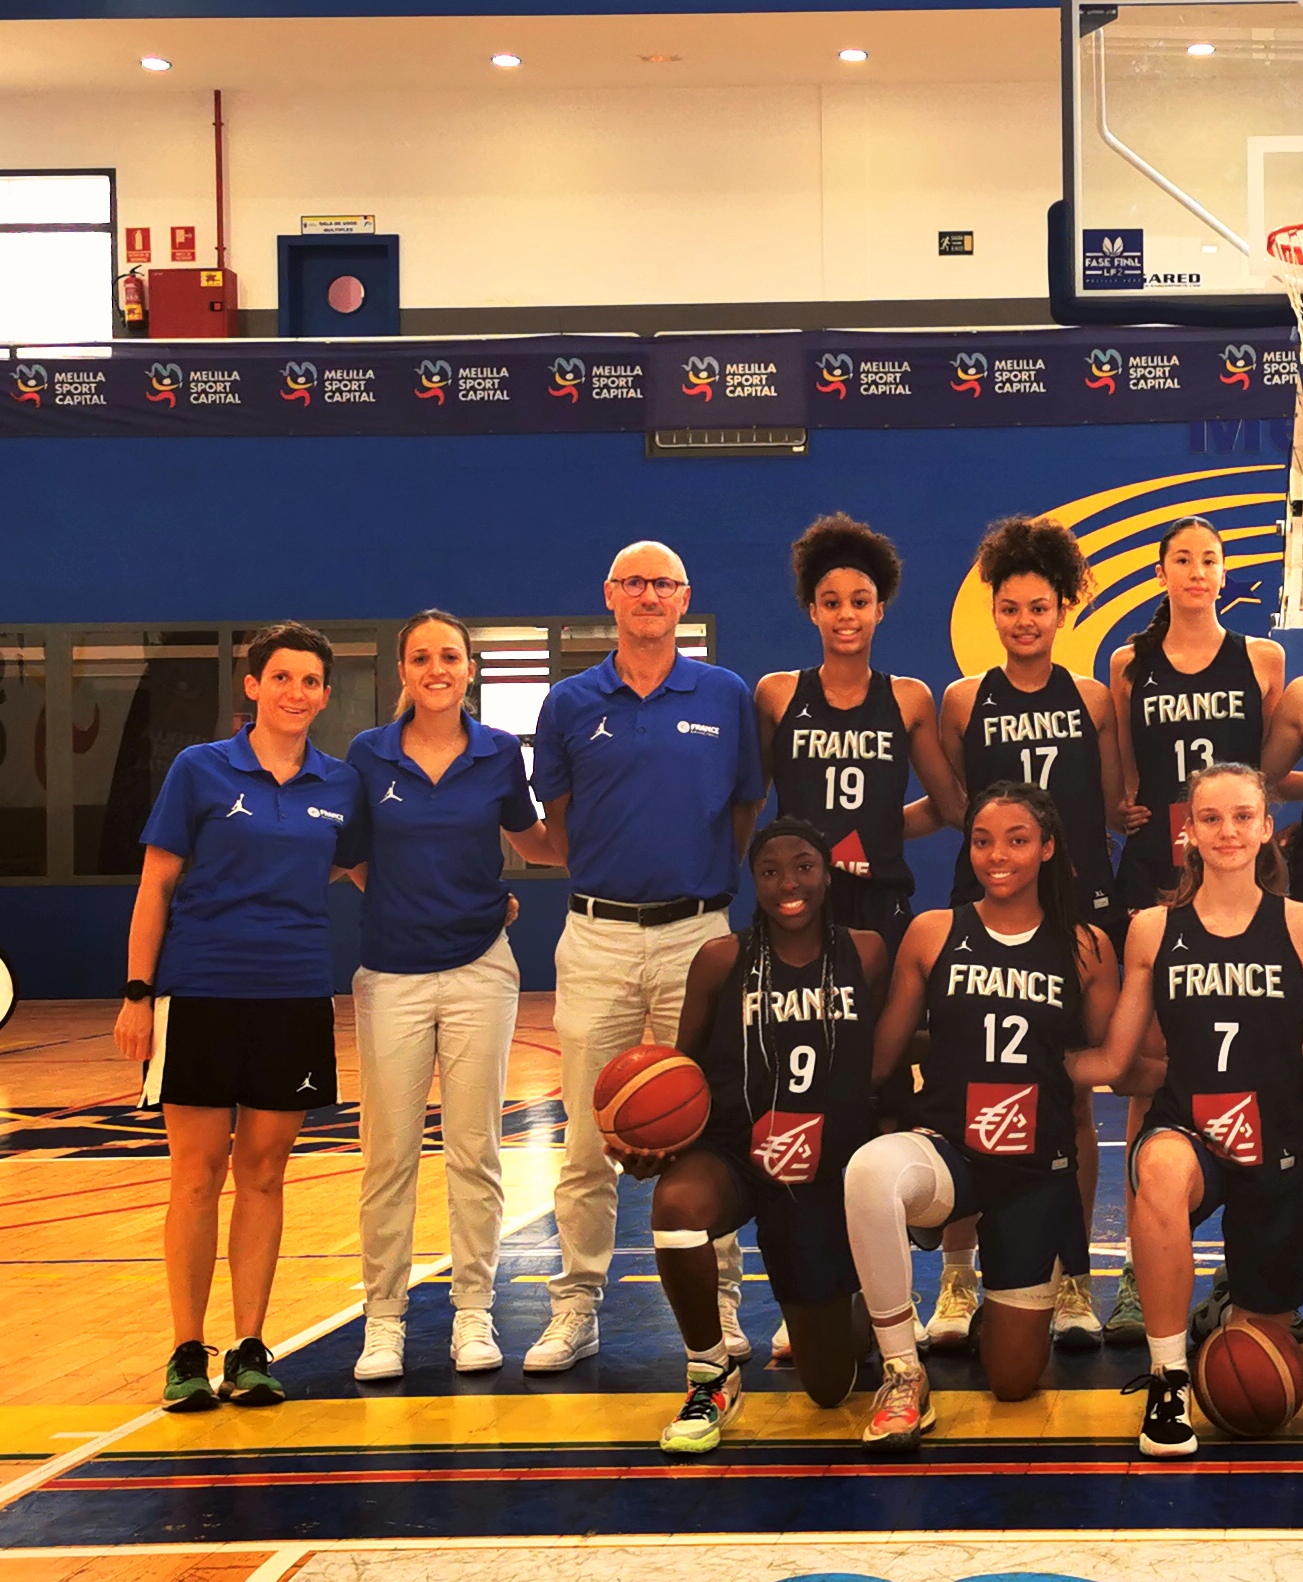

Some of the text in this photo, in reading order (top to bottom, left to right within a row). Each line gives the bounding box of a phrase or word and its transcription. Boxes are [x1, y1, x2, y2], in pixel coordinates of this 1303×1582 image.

[1085, 257, 1142, 267] FASE FINAL
[1129, 355, 1180, 366] MELILLA
[1263, 351, 1298, 362] MELIL
[726, 363, 777, 374] MELILLA
[860, 362, 912, 372] MELILLA
[995, 359, 1046, 370] MELILLA
[1264, 363, 1299, 373] SPOR
[190, 371, 241, 381] MELILLA
[324, 370, 375, 379] MELILLA
[459, 368, 509, 378] MELILLA
[592, 366, 643, 376] MELILLA
[995, 371, 1037, 381] SPORT
[1130, 367, 1171, 378] SPORT
[55, 372, 106, 382] MELILLA
[593, 377, 634, 387] SPORT
[726, 375, 768, 385] SPORT
[861, 373, 902, 383] SPORT
[55, 384, 97, 393] SPORT
[190, 382, 231, 392] SPORT
[325, 381, 366, 391] SPORT
[459, 379, 500, 389] SPORT
[995, 382, 1047, 393] CAPITAL
[1130, 378, 1181, 389] CAPITAL
[459, 390, 510, 400] CAPITAL
[593, 389, 644, 399] CAPITAL
[726, 386, 778, 397] CAPITAL
[861, 385, 912, 395] CAPITAL
[56, 395, 107, 405] CAPITAL
[190, 394, 242, 404] CAPITAL
[325, 392, 376, 402] CAPITAL
[1143, 691, 1246, 727] FRANCE
[984, 709, 1082, 747] FRANCE
[792, 729, 894, 761] FRANCE
[1020, 746, 1058, 790] 17
[825, 766, 865, 810] 19
[947, 963, 1064, 1009] FRANCE
[1168, 962, 1285, 1000] FRANCE
[745, 986, 858, 1026] FRANCE
[983, 1013, 1028, 1064] 12
[1213, 1022, 1240, 1072] 7
[788, 1045, 816, 1093] 9
